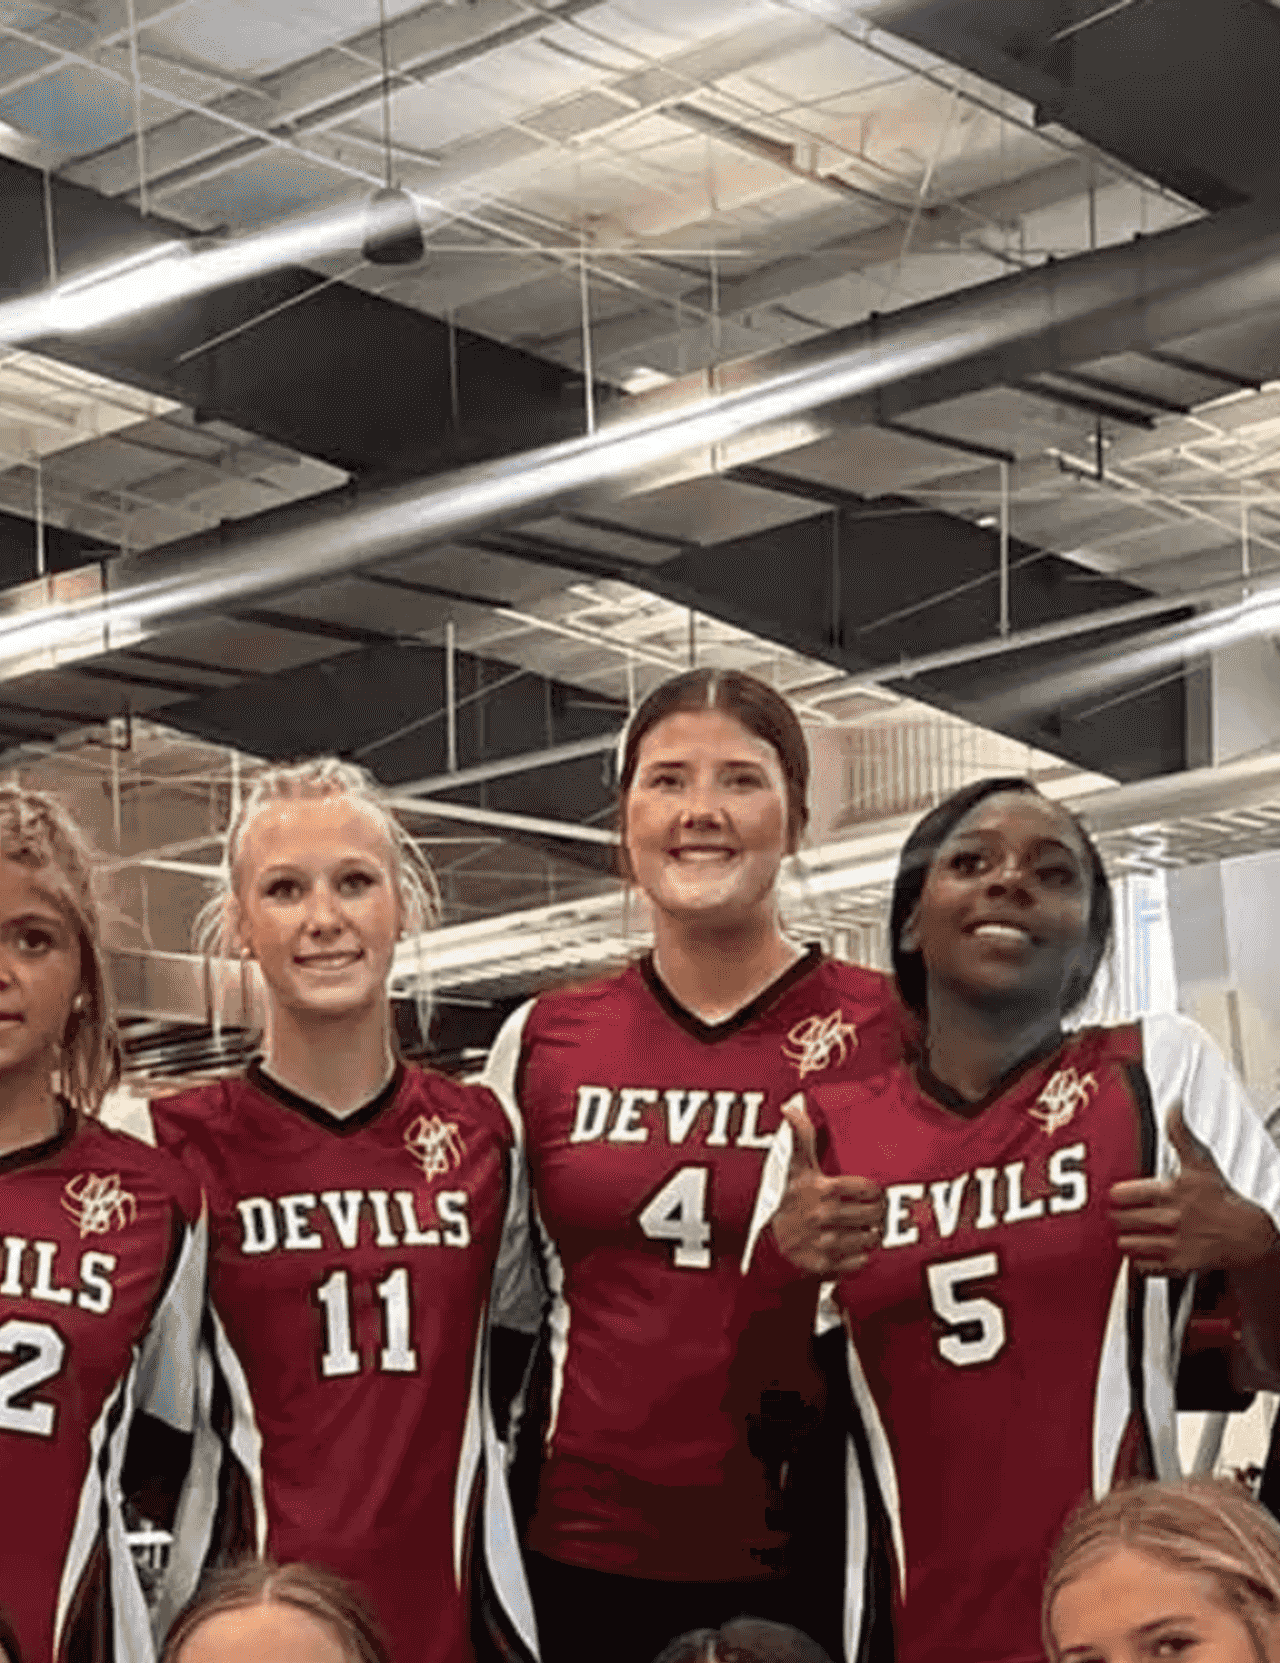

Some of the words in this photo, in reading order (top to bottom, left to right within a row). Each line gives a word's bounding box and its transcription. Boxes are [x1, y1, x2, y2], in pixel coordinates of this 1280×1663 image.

[569, 1085, 778, 1148] DEVIL
[237, 1190, 470, 1253] DEVILS
[639, 1167, 711, 1269] 4
[881, 1143, 1088, 1249] EVILS
[317, 1268, 417, 1377] 11
[927, 1252, 1006, 1366] 5
